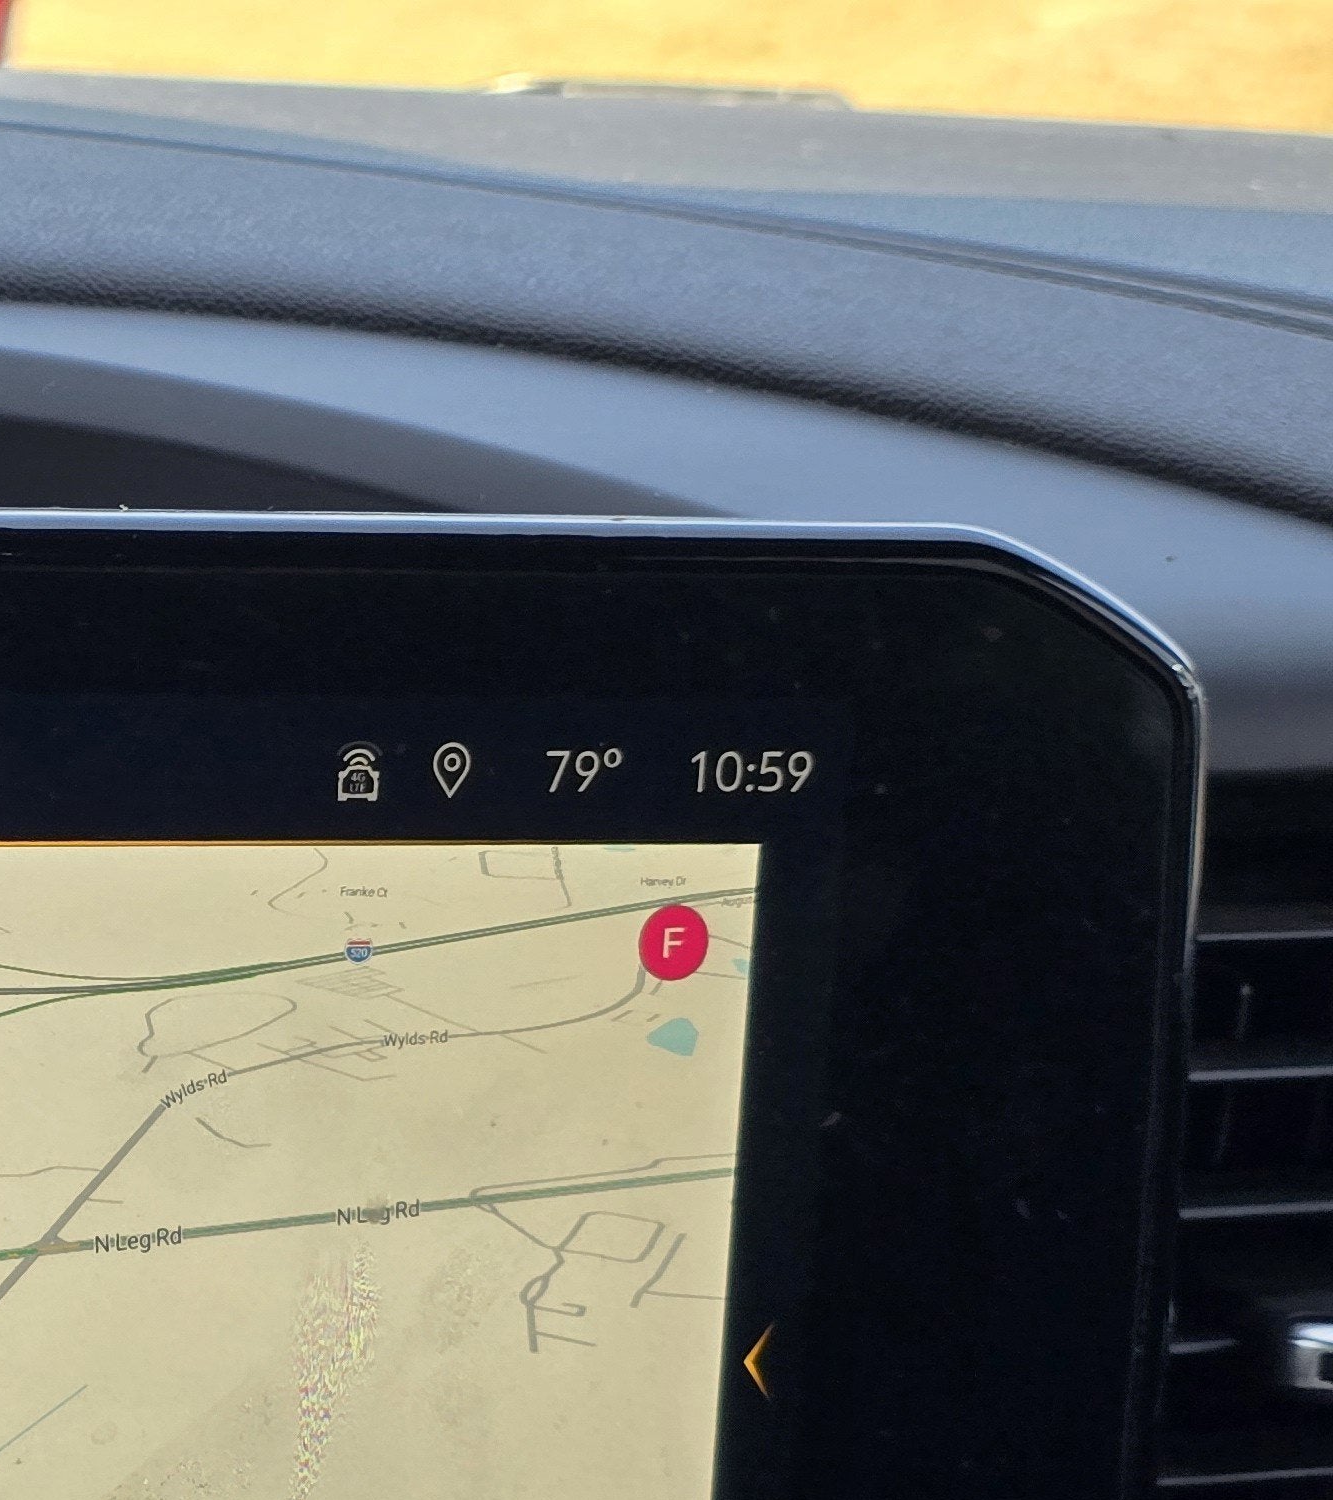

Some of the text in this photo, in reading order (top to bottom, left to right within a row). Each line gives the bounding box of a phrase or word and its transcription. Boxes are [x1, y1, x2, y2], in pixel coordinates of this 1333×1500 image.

[350, 772, 366, 783] 4G
[691, 750, 815, 793] 10:59
[349, 782, 366, 793] LTE
[663, 927, 685, 958] F
[383, 1029, 449, 1049] Wylds Rd
[160, 1068, 229, 1108] Wylds Rd
[337, 1198, 420, 1226] N Lg Rd
[94, 1225, 183, 1254] N Leg Rd
